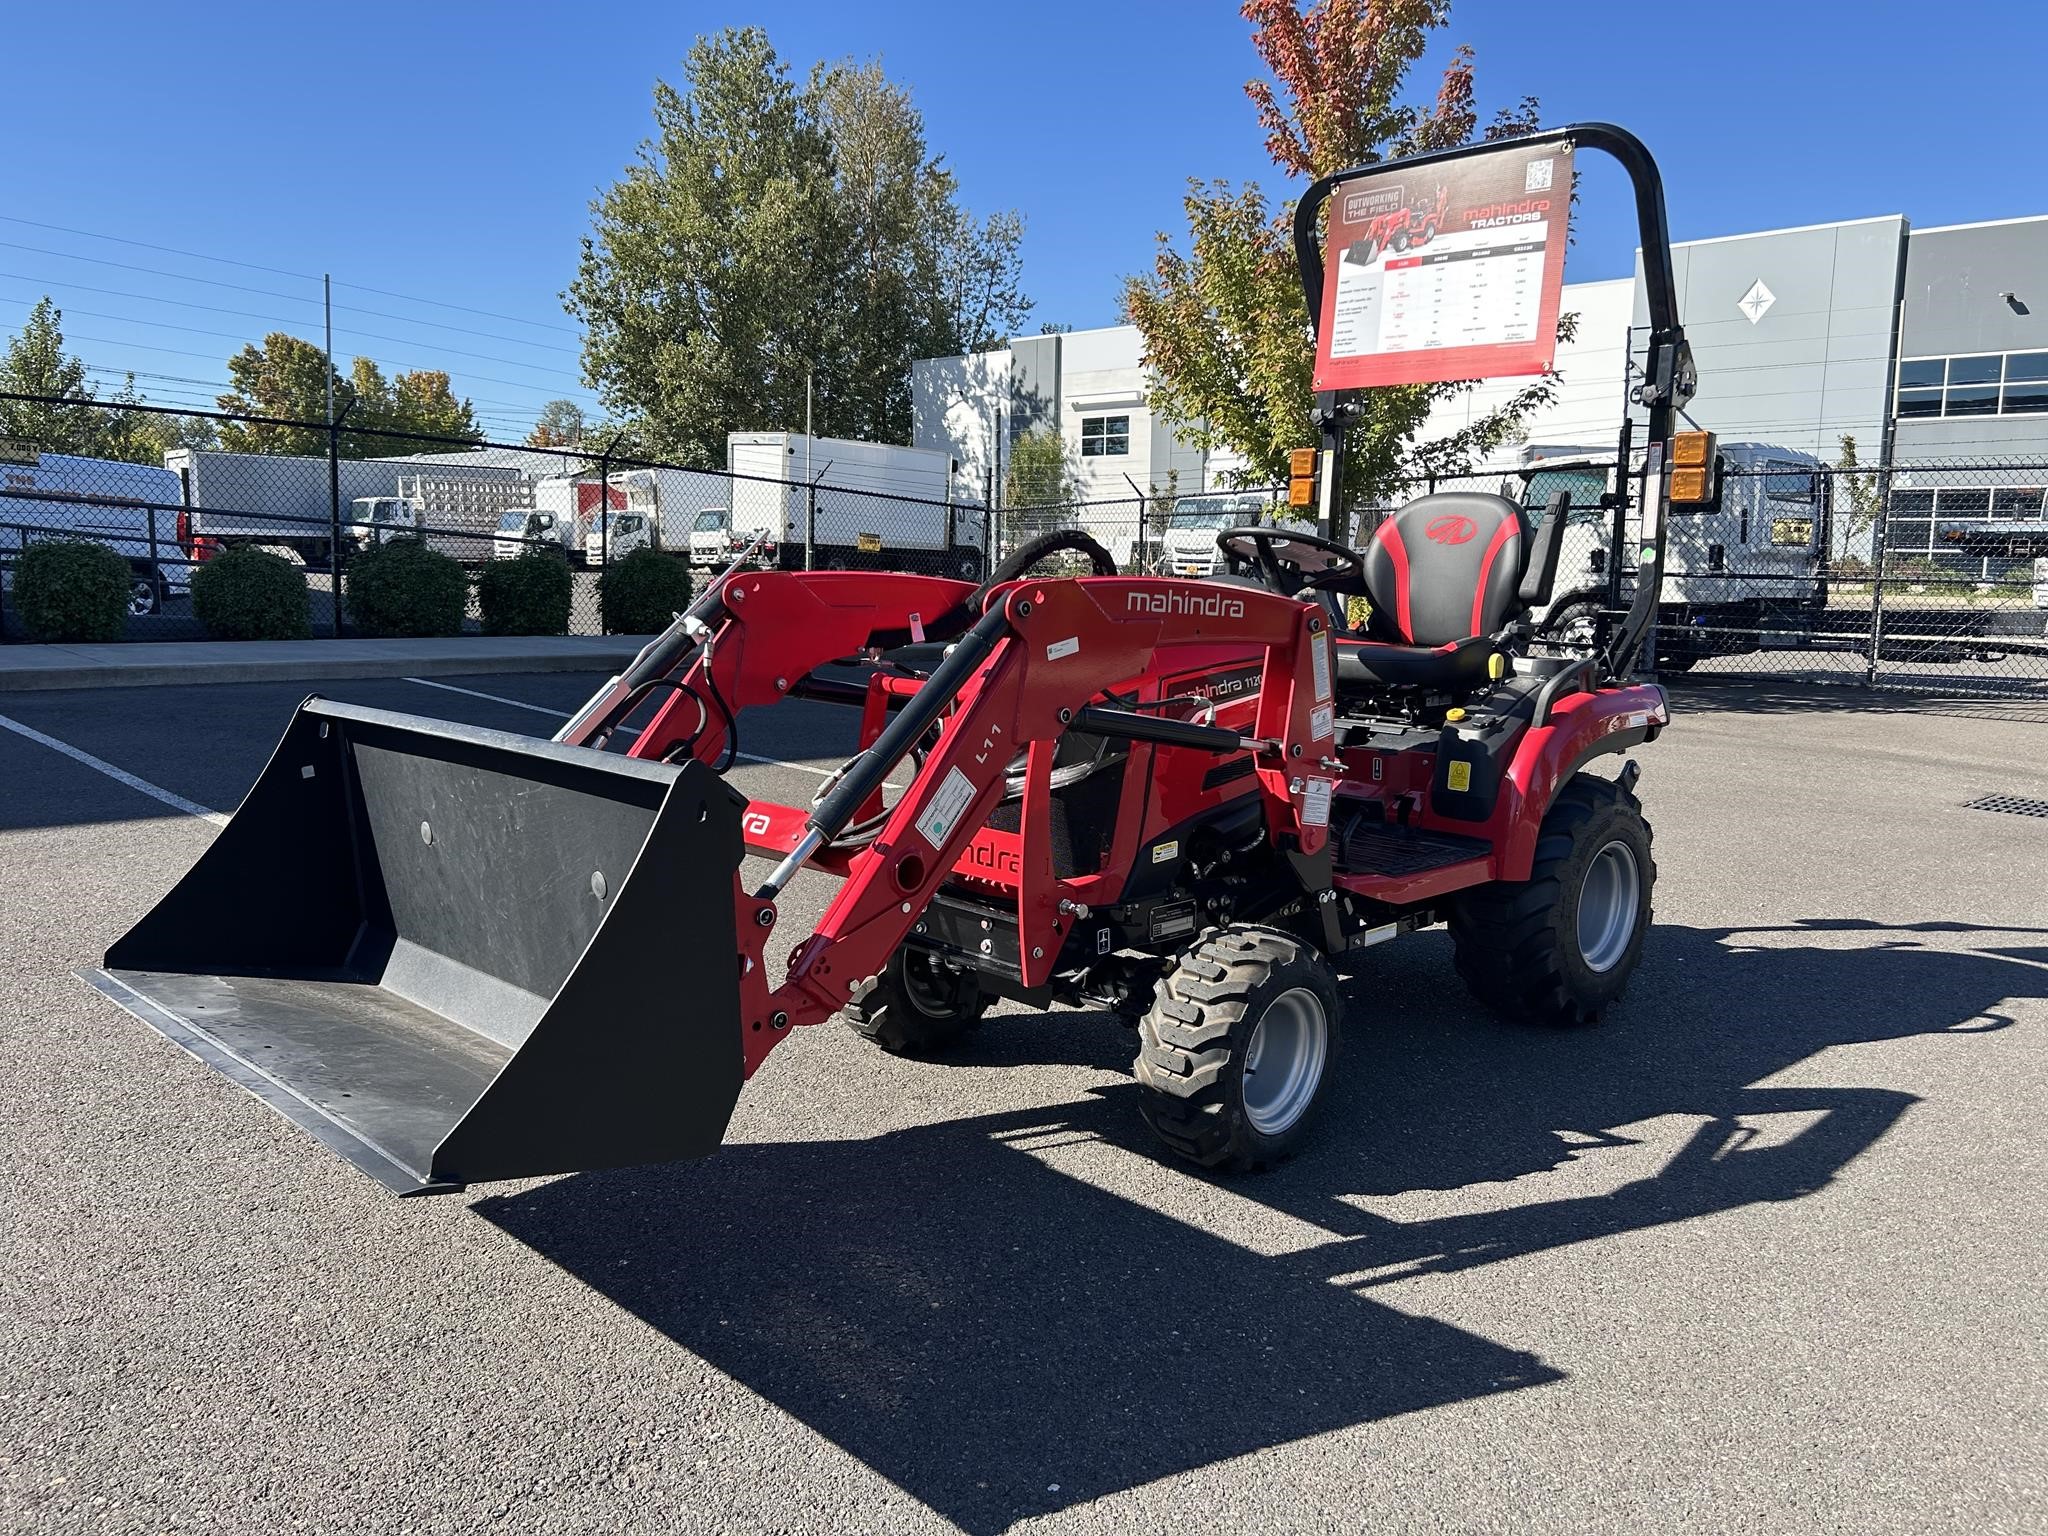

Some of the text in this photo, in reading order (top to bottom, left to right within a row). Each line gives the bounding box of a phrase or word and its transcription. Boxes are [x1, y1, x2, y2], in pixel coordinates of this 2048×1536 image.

[1348, 191, 1399, 210] OUTWORKING
[1463, 200, 1550, 221] mahindra
[1348, 203, 1398, 219] THE FIELD
[1470, 211, 1541, 229] TRACTORS
[1127, 589, 1244, 618] mahindra
[975, 723, 1002, 764] L11
